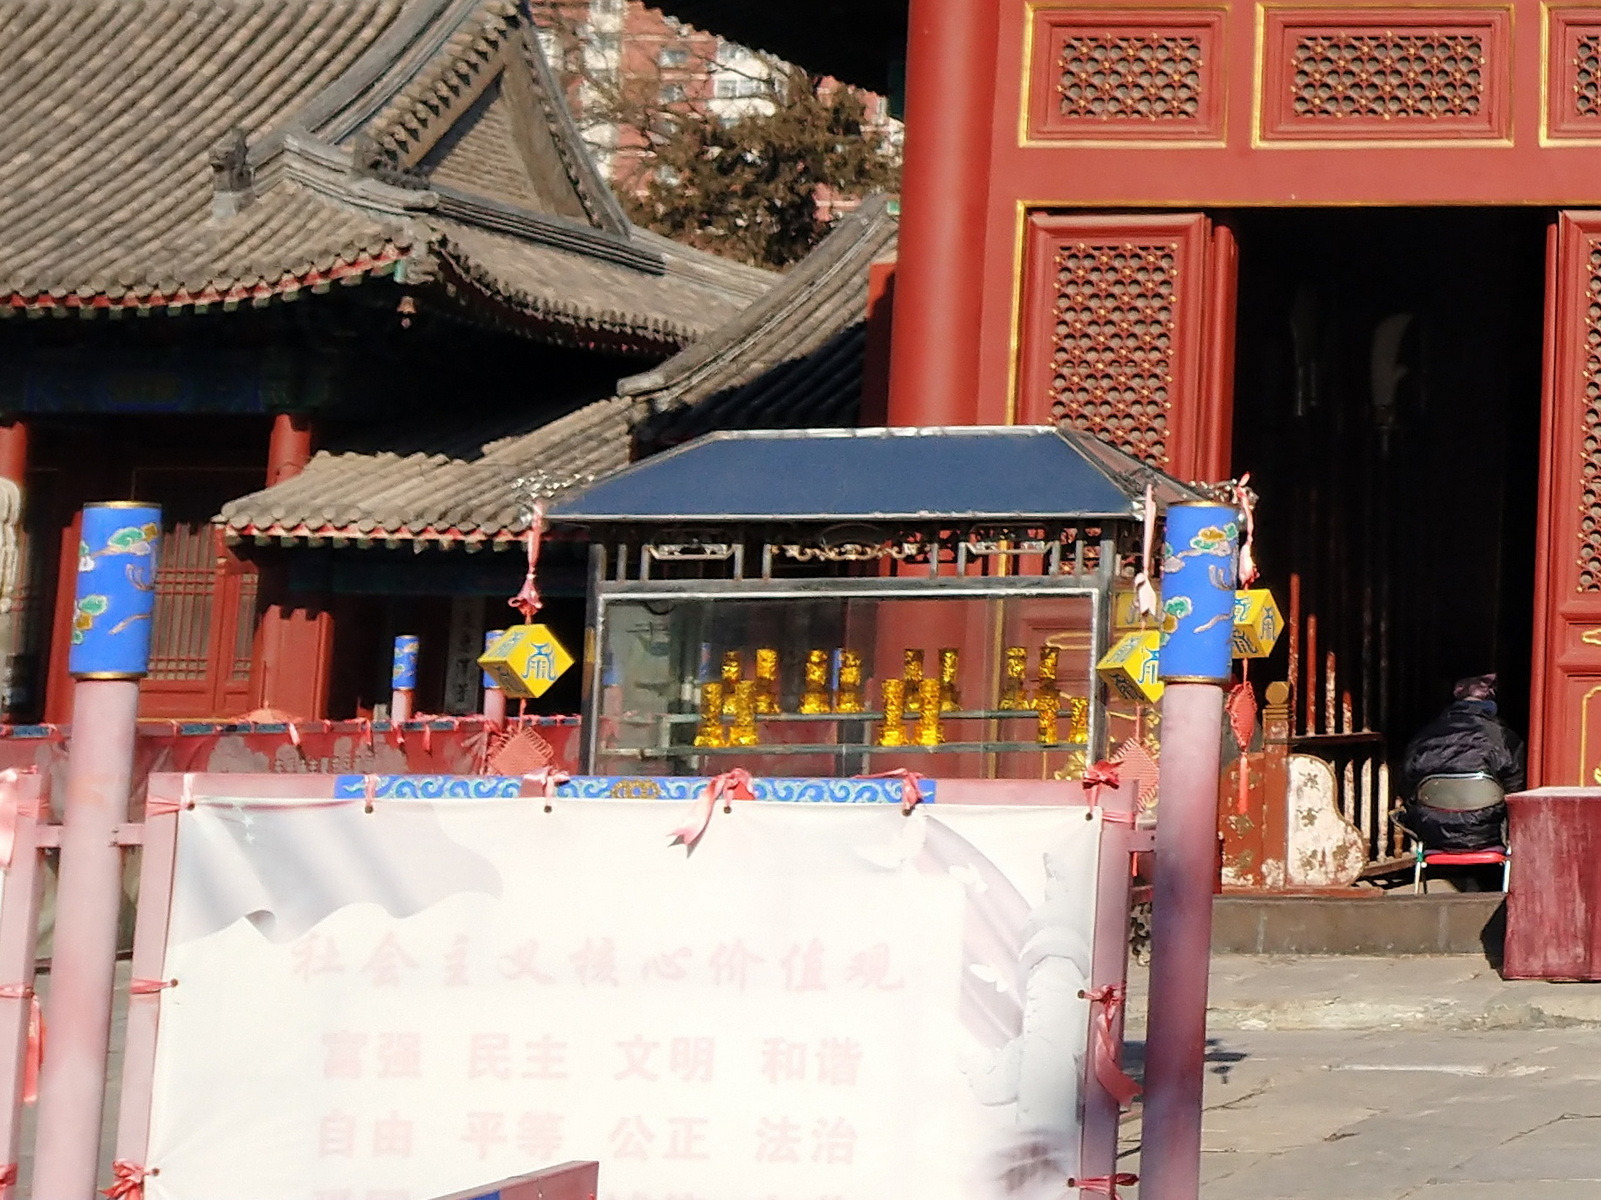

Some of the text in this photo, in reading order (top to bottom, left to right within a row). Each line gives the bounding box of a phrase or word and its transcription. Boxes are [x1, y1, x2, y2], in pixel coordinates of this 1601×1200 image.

[291, 931, 906, 993] 社会主义核心价值观
[322, 1029, 862, 1086] 富强 民主 文明 和谐
[316, 1110, 858, 1164] 自由 平等 公正 法治
